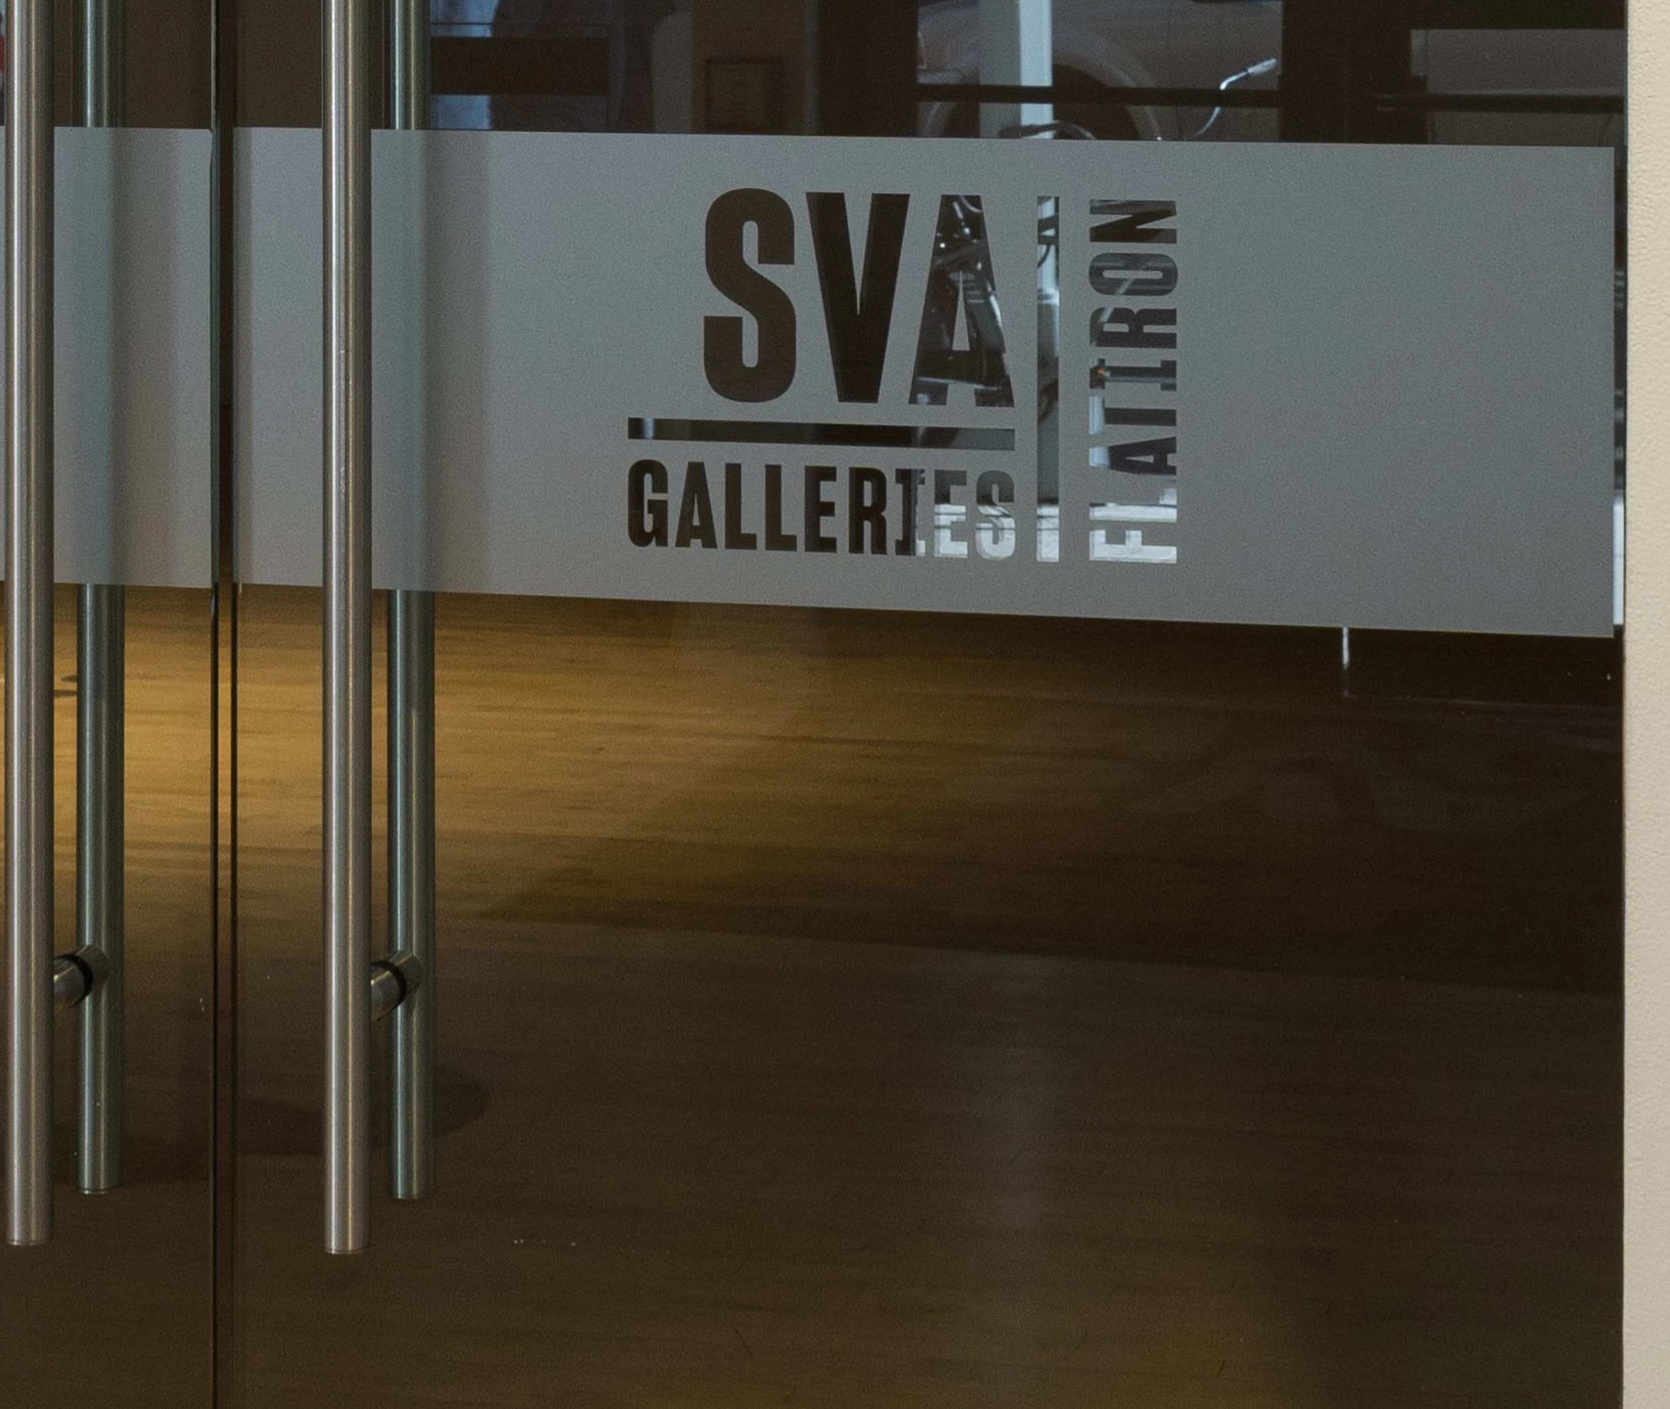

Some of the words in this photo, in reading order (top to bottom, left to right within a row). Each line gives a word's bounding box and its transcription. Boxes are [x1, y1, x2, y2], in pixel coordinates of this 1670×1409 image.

[703, 187, 1015, 407] SVA
[1088, 198, 1179, 565] FLATIRON
[627, 458, 1016, 561] GALLERIES
